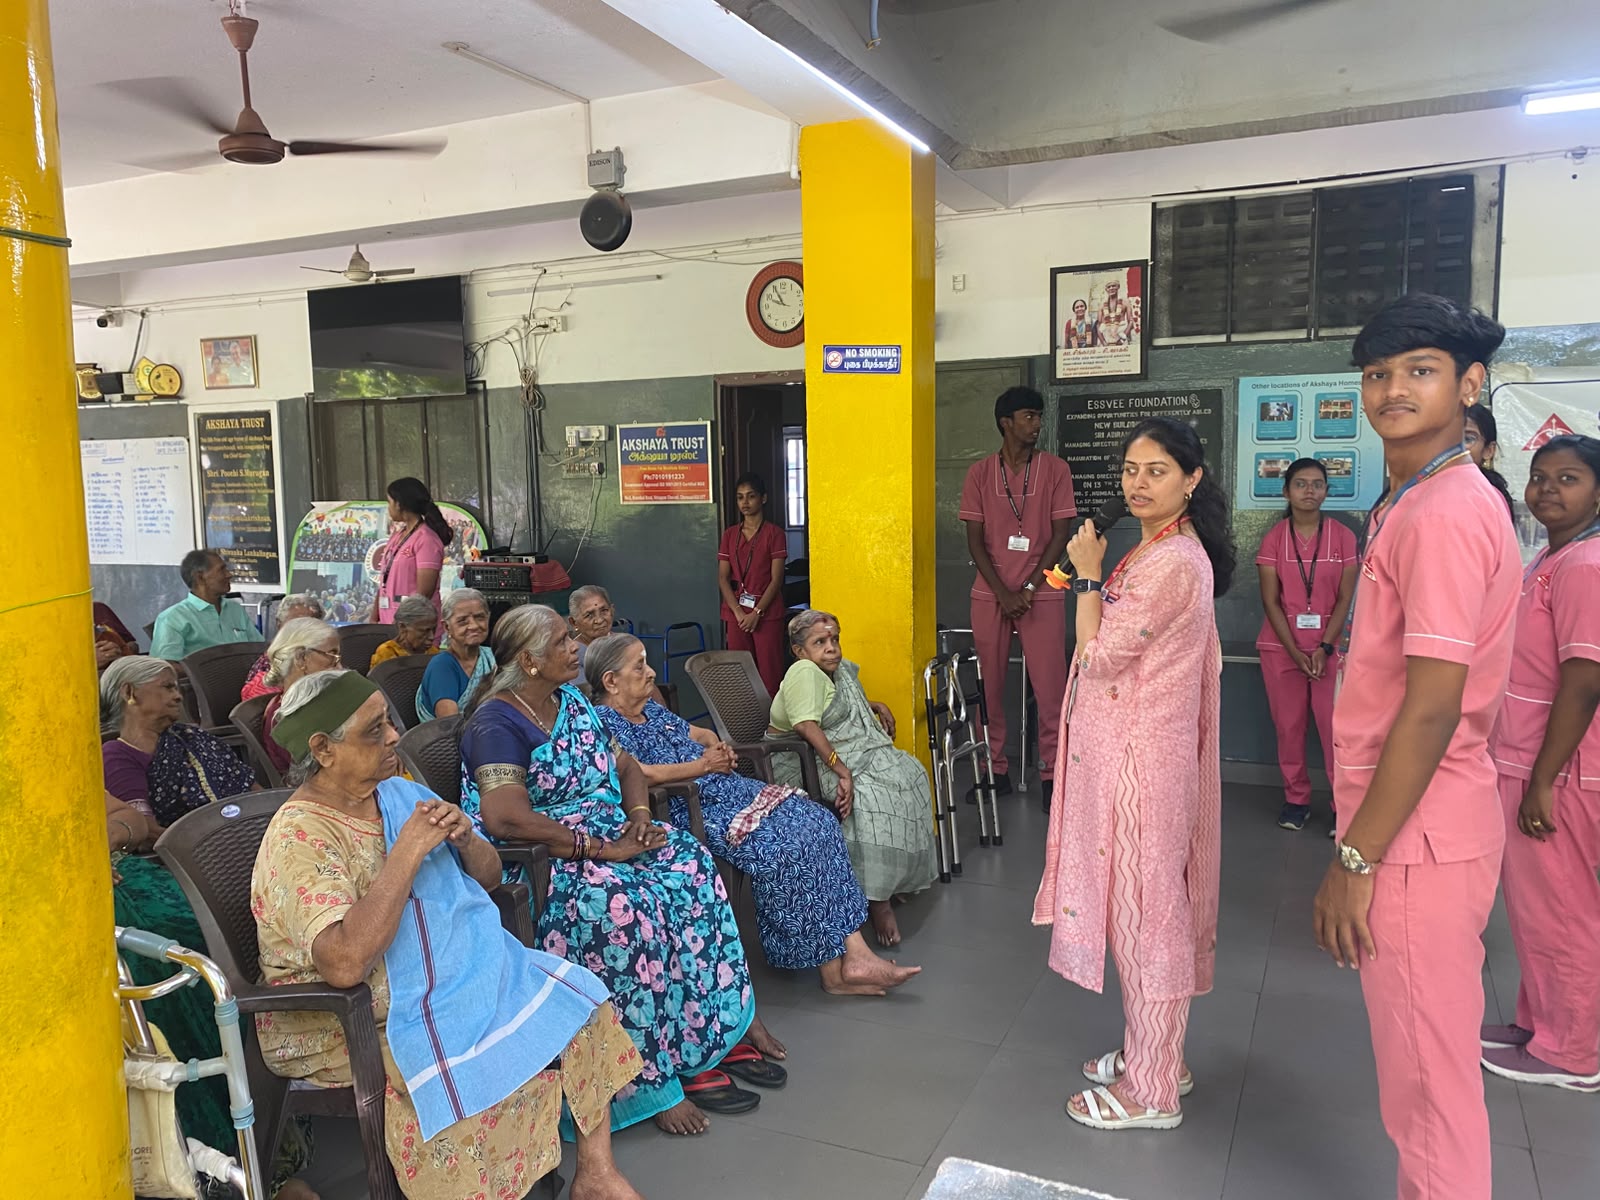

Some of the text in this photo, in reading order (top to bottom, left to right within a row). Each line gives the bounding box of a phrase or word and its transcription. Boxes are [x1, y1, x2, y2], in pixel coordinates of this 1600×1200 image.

[589, 159, 610, 167] EDISON
[766, 293, 773, 301] 10
[845, 348, 897, 357] NO SMOKING
[1310, 380, 1337, 388] Akshaya
[1087, 395, 1188, 410] ESSVEE FOUNDATION
[206, 417, 265, 430] AKSHAYA TRUST
[1094, 421, 1111, 429] NEW
[1094, 431, 1105, 439] SRI
[622, 437, 705, 451] AKSHAYA TRUST
[1082, 481, 1092, 489] ON
